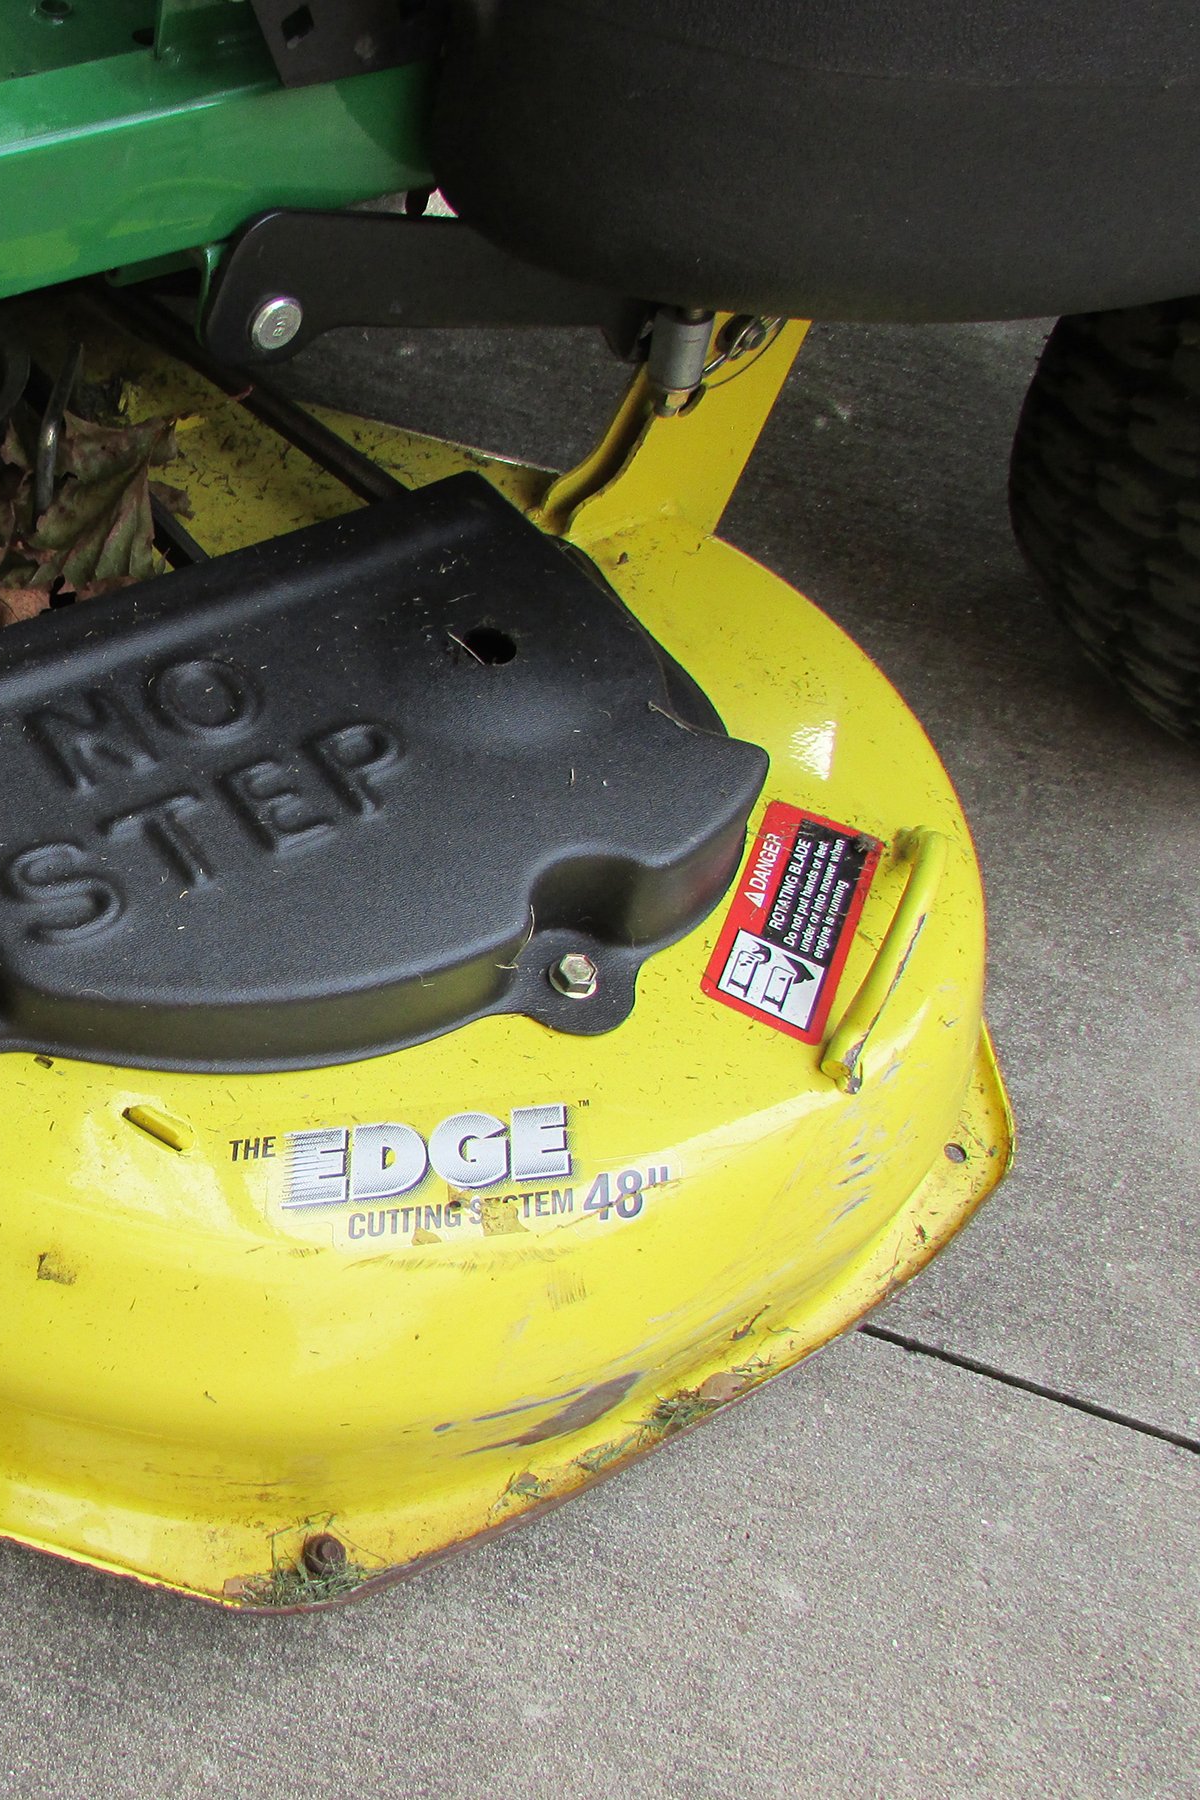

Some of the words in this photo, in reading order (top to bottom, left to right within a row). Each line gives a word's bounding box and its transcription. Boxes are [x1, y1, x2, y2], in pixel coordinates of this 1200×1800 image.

[22, 656, 262, 795] NO
[749, 833, 781, 891] DANGER
[812, 858, 823, 869] or
[813, 841, 829, 858] feet
[830, 839, 846, 862] when
[768, 874, 799, 931] ROTATING
[788, 838, 811, 875] BLADE
[800, 870, 819, 898] hands
[820, 862, 837, 893] mower
[797, 897, 810, 916] put
[811, 893, 826, 912] into
[828, 880, 849, 915] running
[791, 913, 804, 931] not
[809, 911, 820, 923] or
[822, 915, 835, 926] is
[783, 931, 797, 946] Do
[800, 923, 816, 953] under
[813, 926, 831, 959] engine
[229, 1136, 277, 1162] THE
[279, 1102, 575, 1209] EDGE
[348, 1199, 462, 1240] CUTTING
[468, 1187, 574, 1225] STEM
[583, 1165, 669, 1221] 48"
